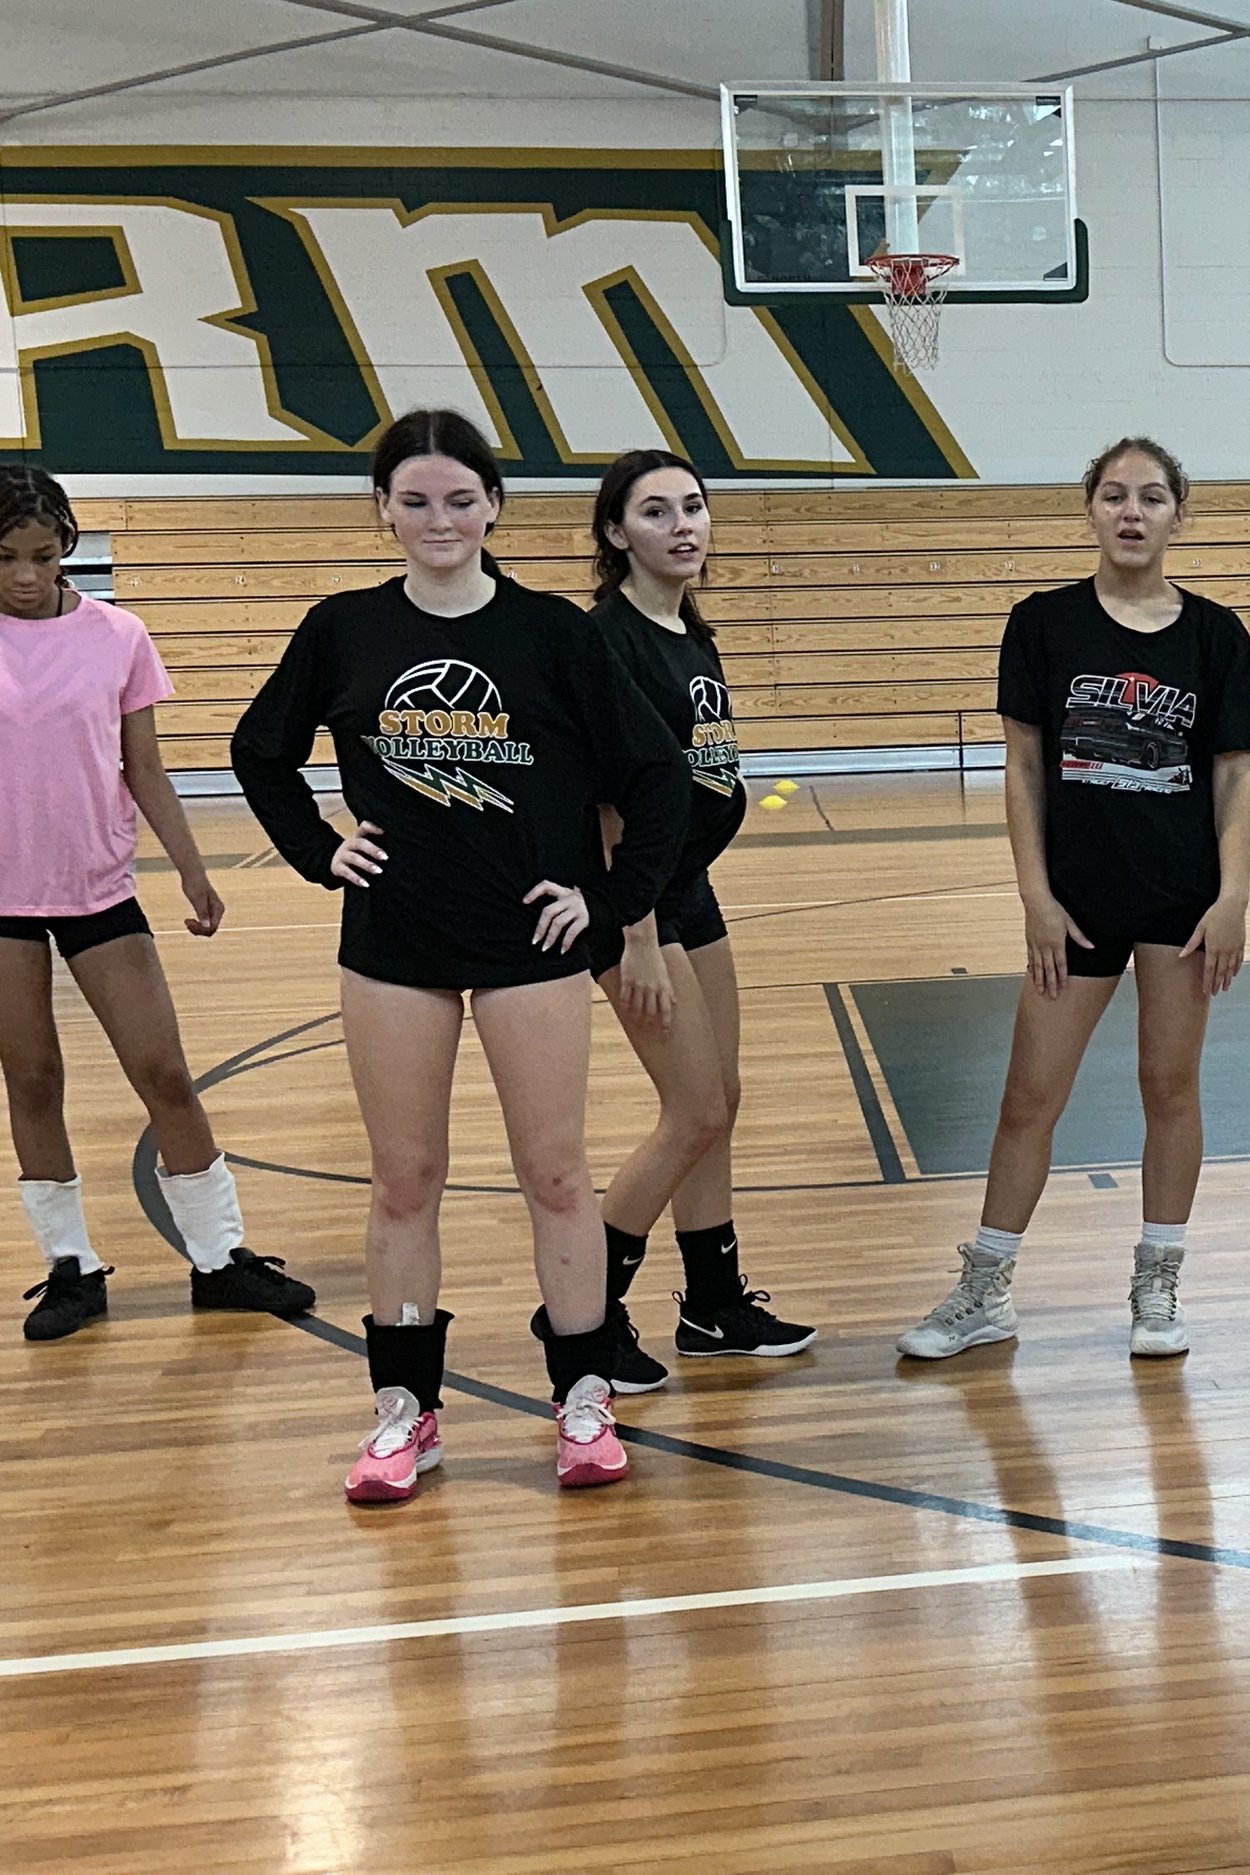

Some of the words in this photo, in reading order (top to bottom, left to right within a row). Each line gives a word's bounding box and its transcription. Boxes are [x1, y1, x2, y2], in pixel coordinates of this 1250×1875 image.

[1065, 674, 1197, 728] SILVIA
[378, 709, 510, 739] STORM
[692, 720, 737, 747] STOR
